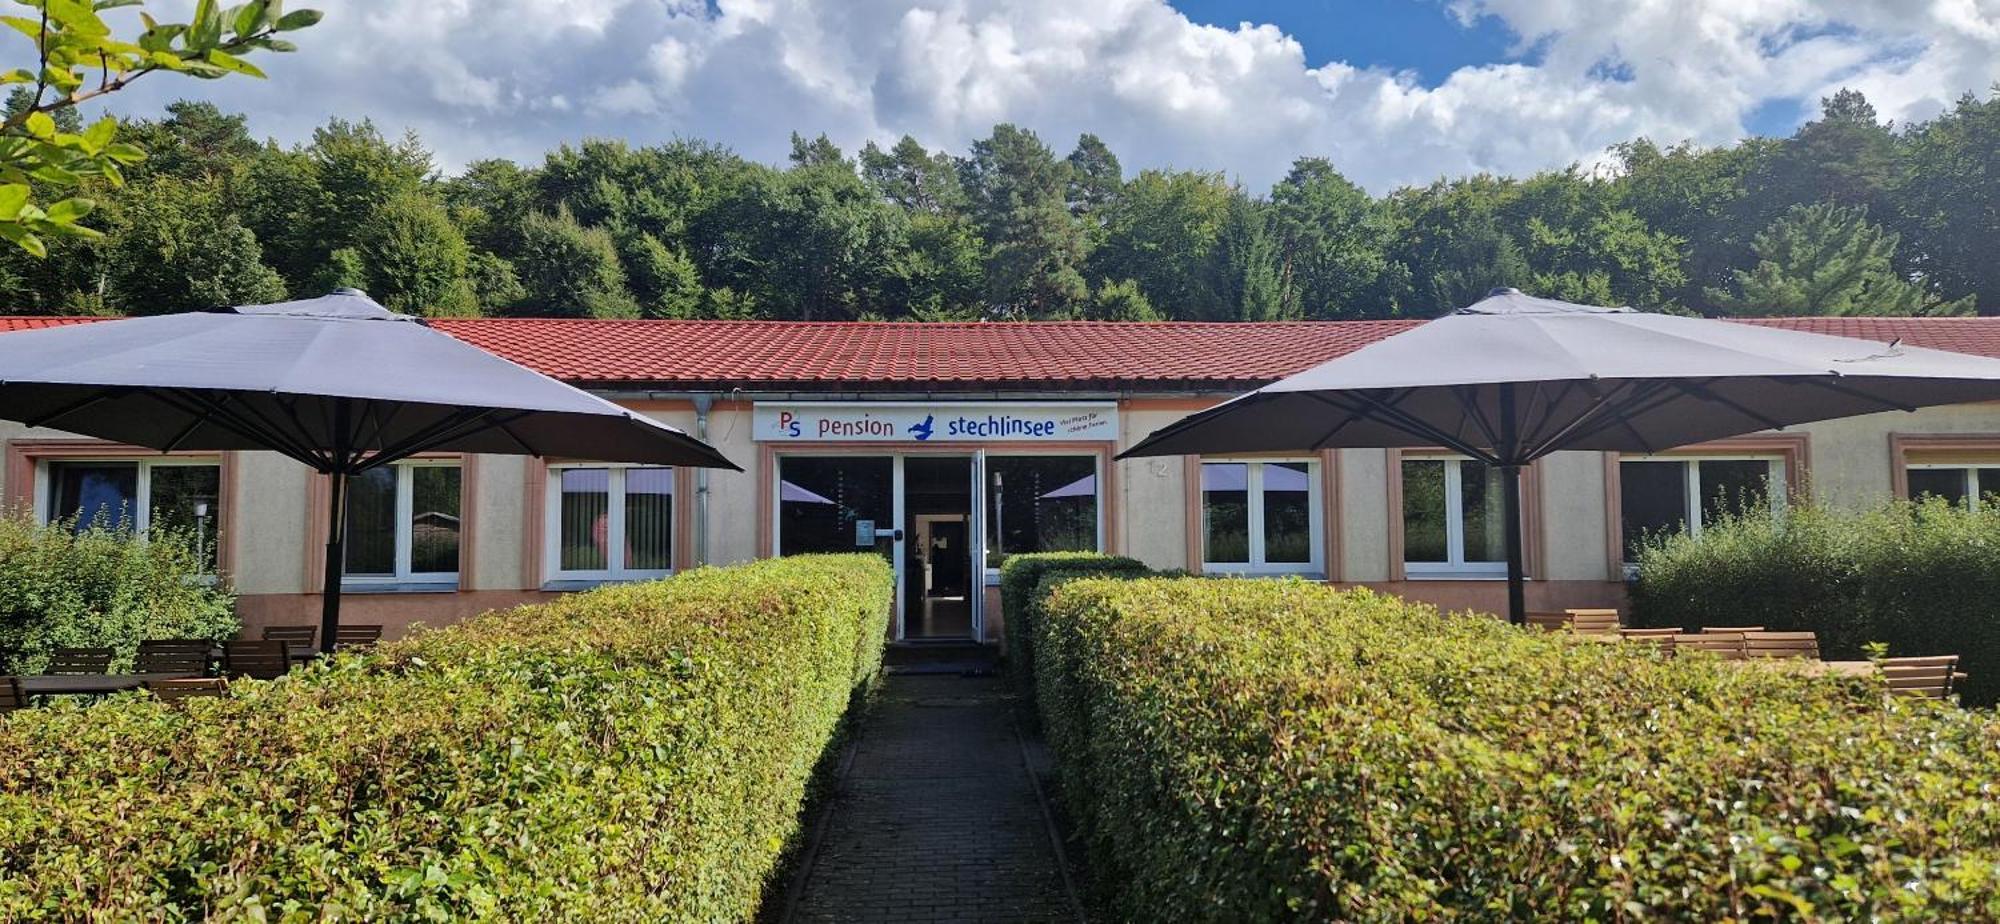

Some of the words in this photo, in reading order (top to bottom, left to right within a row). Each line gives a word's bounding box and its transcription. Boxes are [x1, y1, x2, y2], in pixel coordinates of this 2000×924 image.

[780, 411, 800, 437] PS
[819, 412, 894, 438] pension
[948, 415, 1055, 436] stechlinsee
